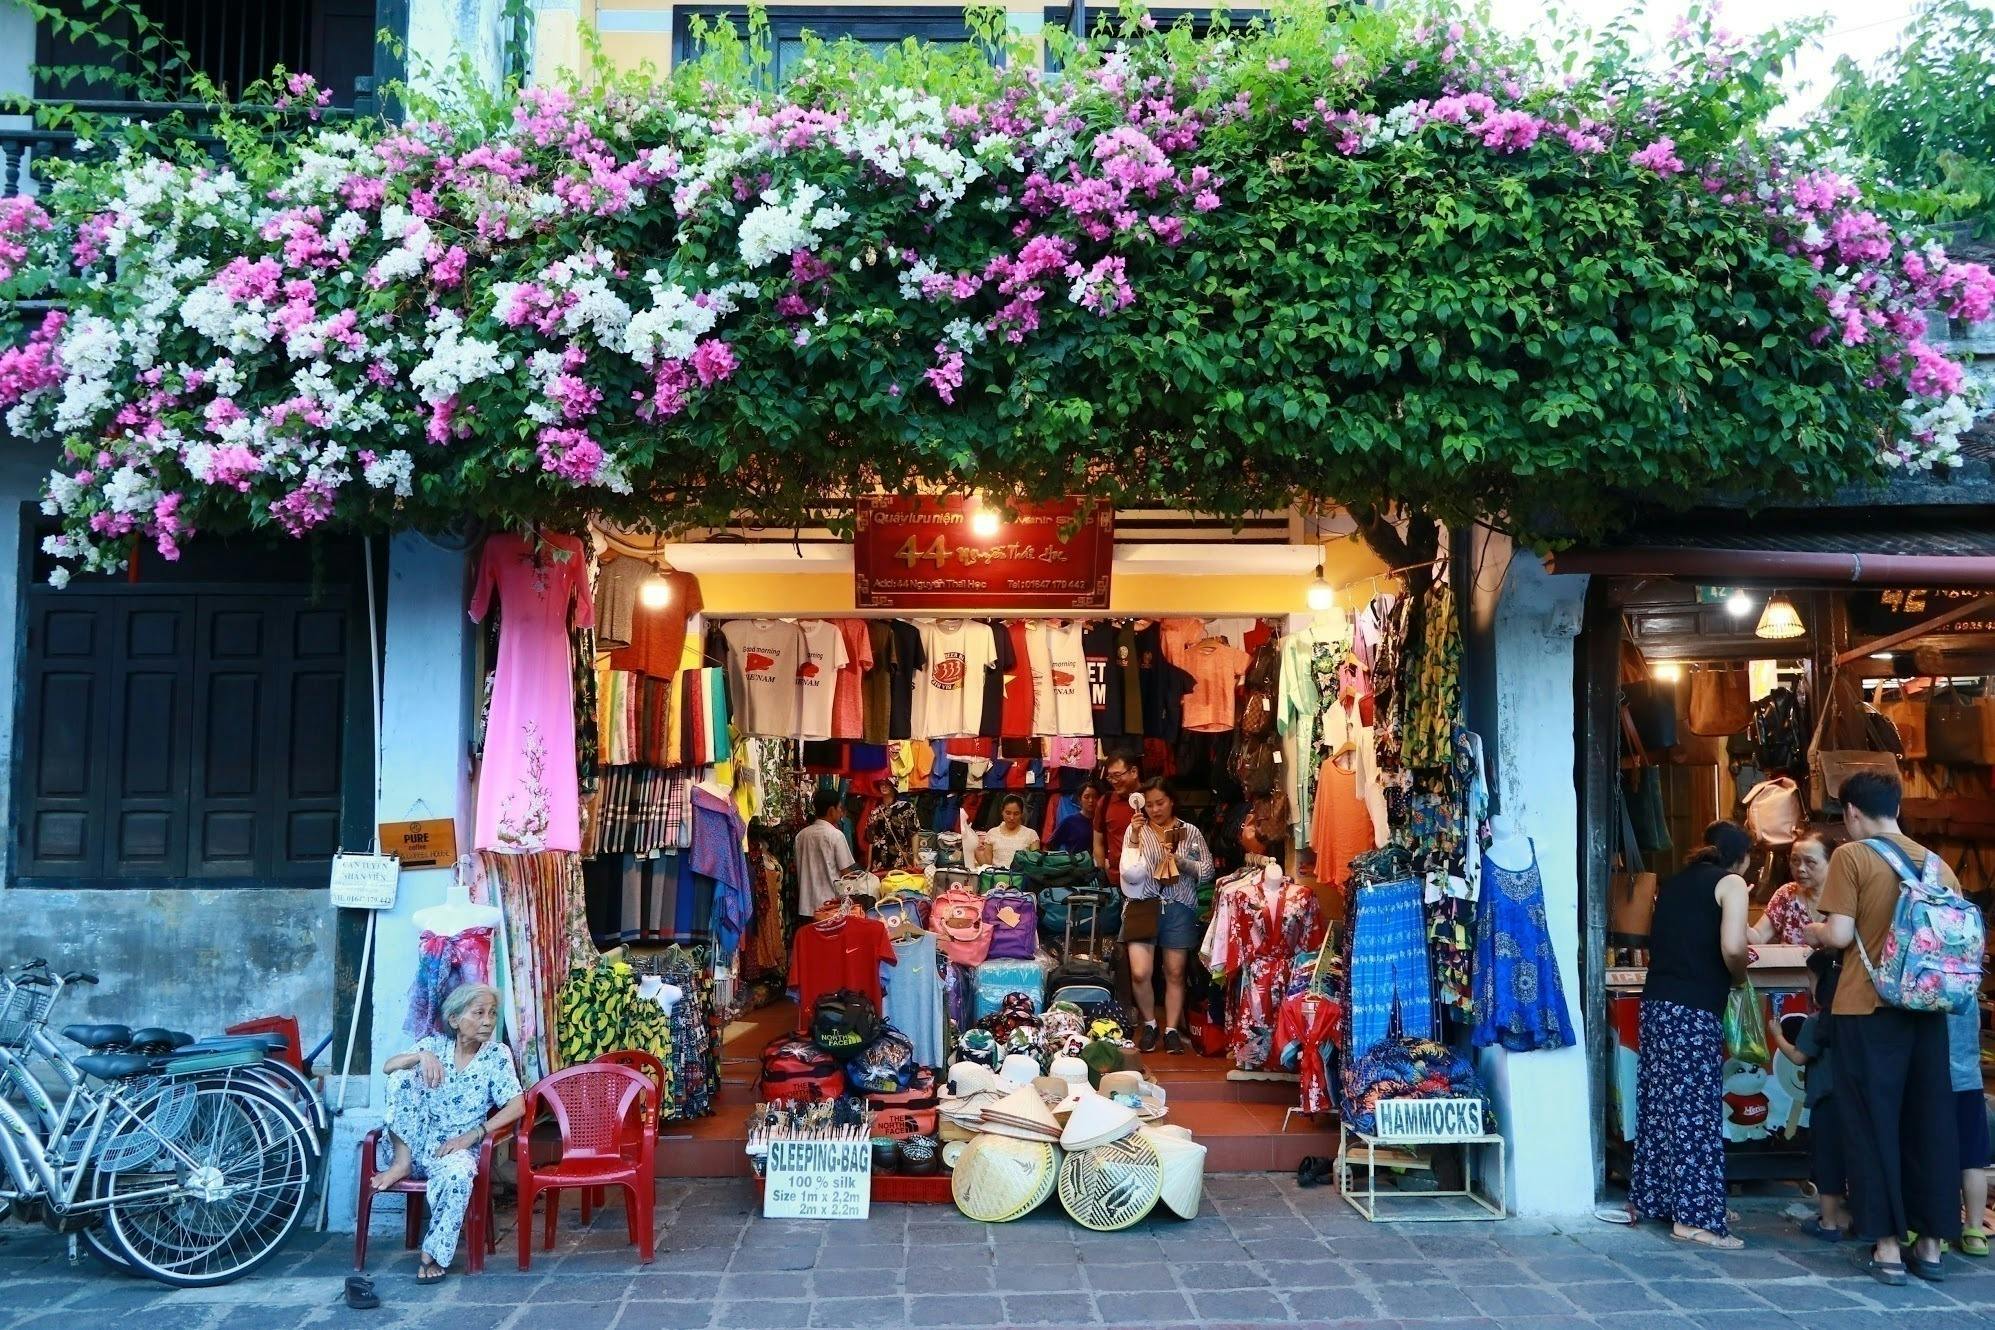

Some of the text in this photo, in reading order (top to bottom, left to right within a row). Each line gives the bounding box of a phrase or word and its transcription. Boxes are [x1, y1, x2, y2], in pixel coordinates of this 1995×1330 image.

[932, 511, 964, 526] niệm
[894, 534, 953, 568] 44
[756, 647, 781, 657] morning
[807, 652, 824, 660] orning
[1087, 662, 1107, 683] ET
[403, 832, 430, 844] PURE
[408, 843, 427, 851] coffee
[793, 1082, 809, 1090] THE
[1380, 1101, 1481, 1136] HAMMOCKS
[878, 1121, 905, 1130] NORTH
[885, 1128, 905, 1136] FACE
[770, 1142, 868, 1173] SLEEPING-BAG
[788, 1175, 856, 1189] 100 % silk
[772, 1190, 797, 1202] Size
[801, 1191, 818, 1202] 1m
[822, 1194, 828, 1202] x
[799, 1204, 817, 1215] 2m
[820, 1206, 827, 1215] x
